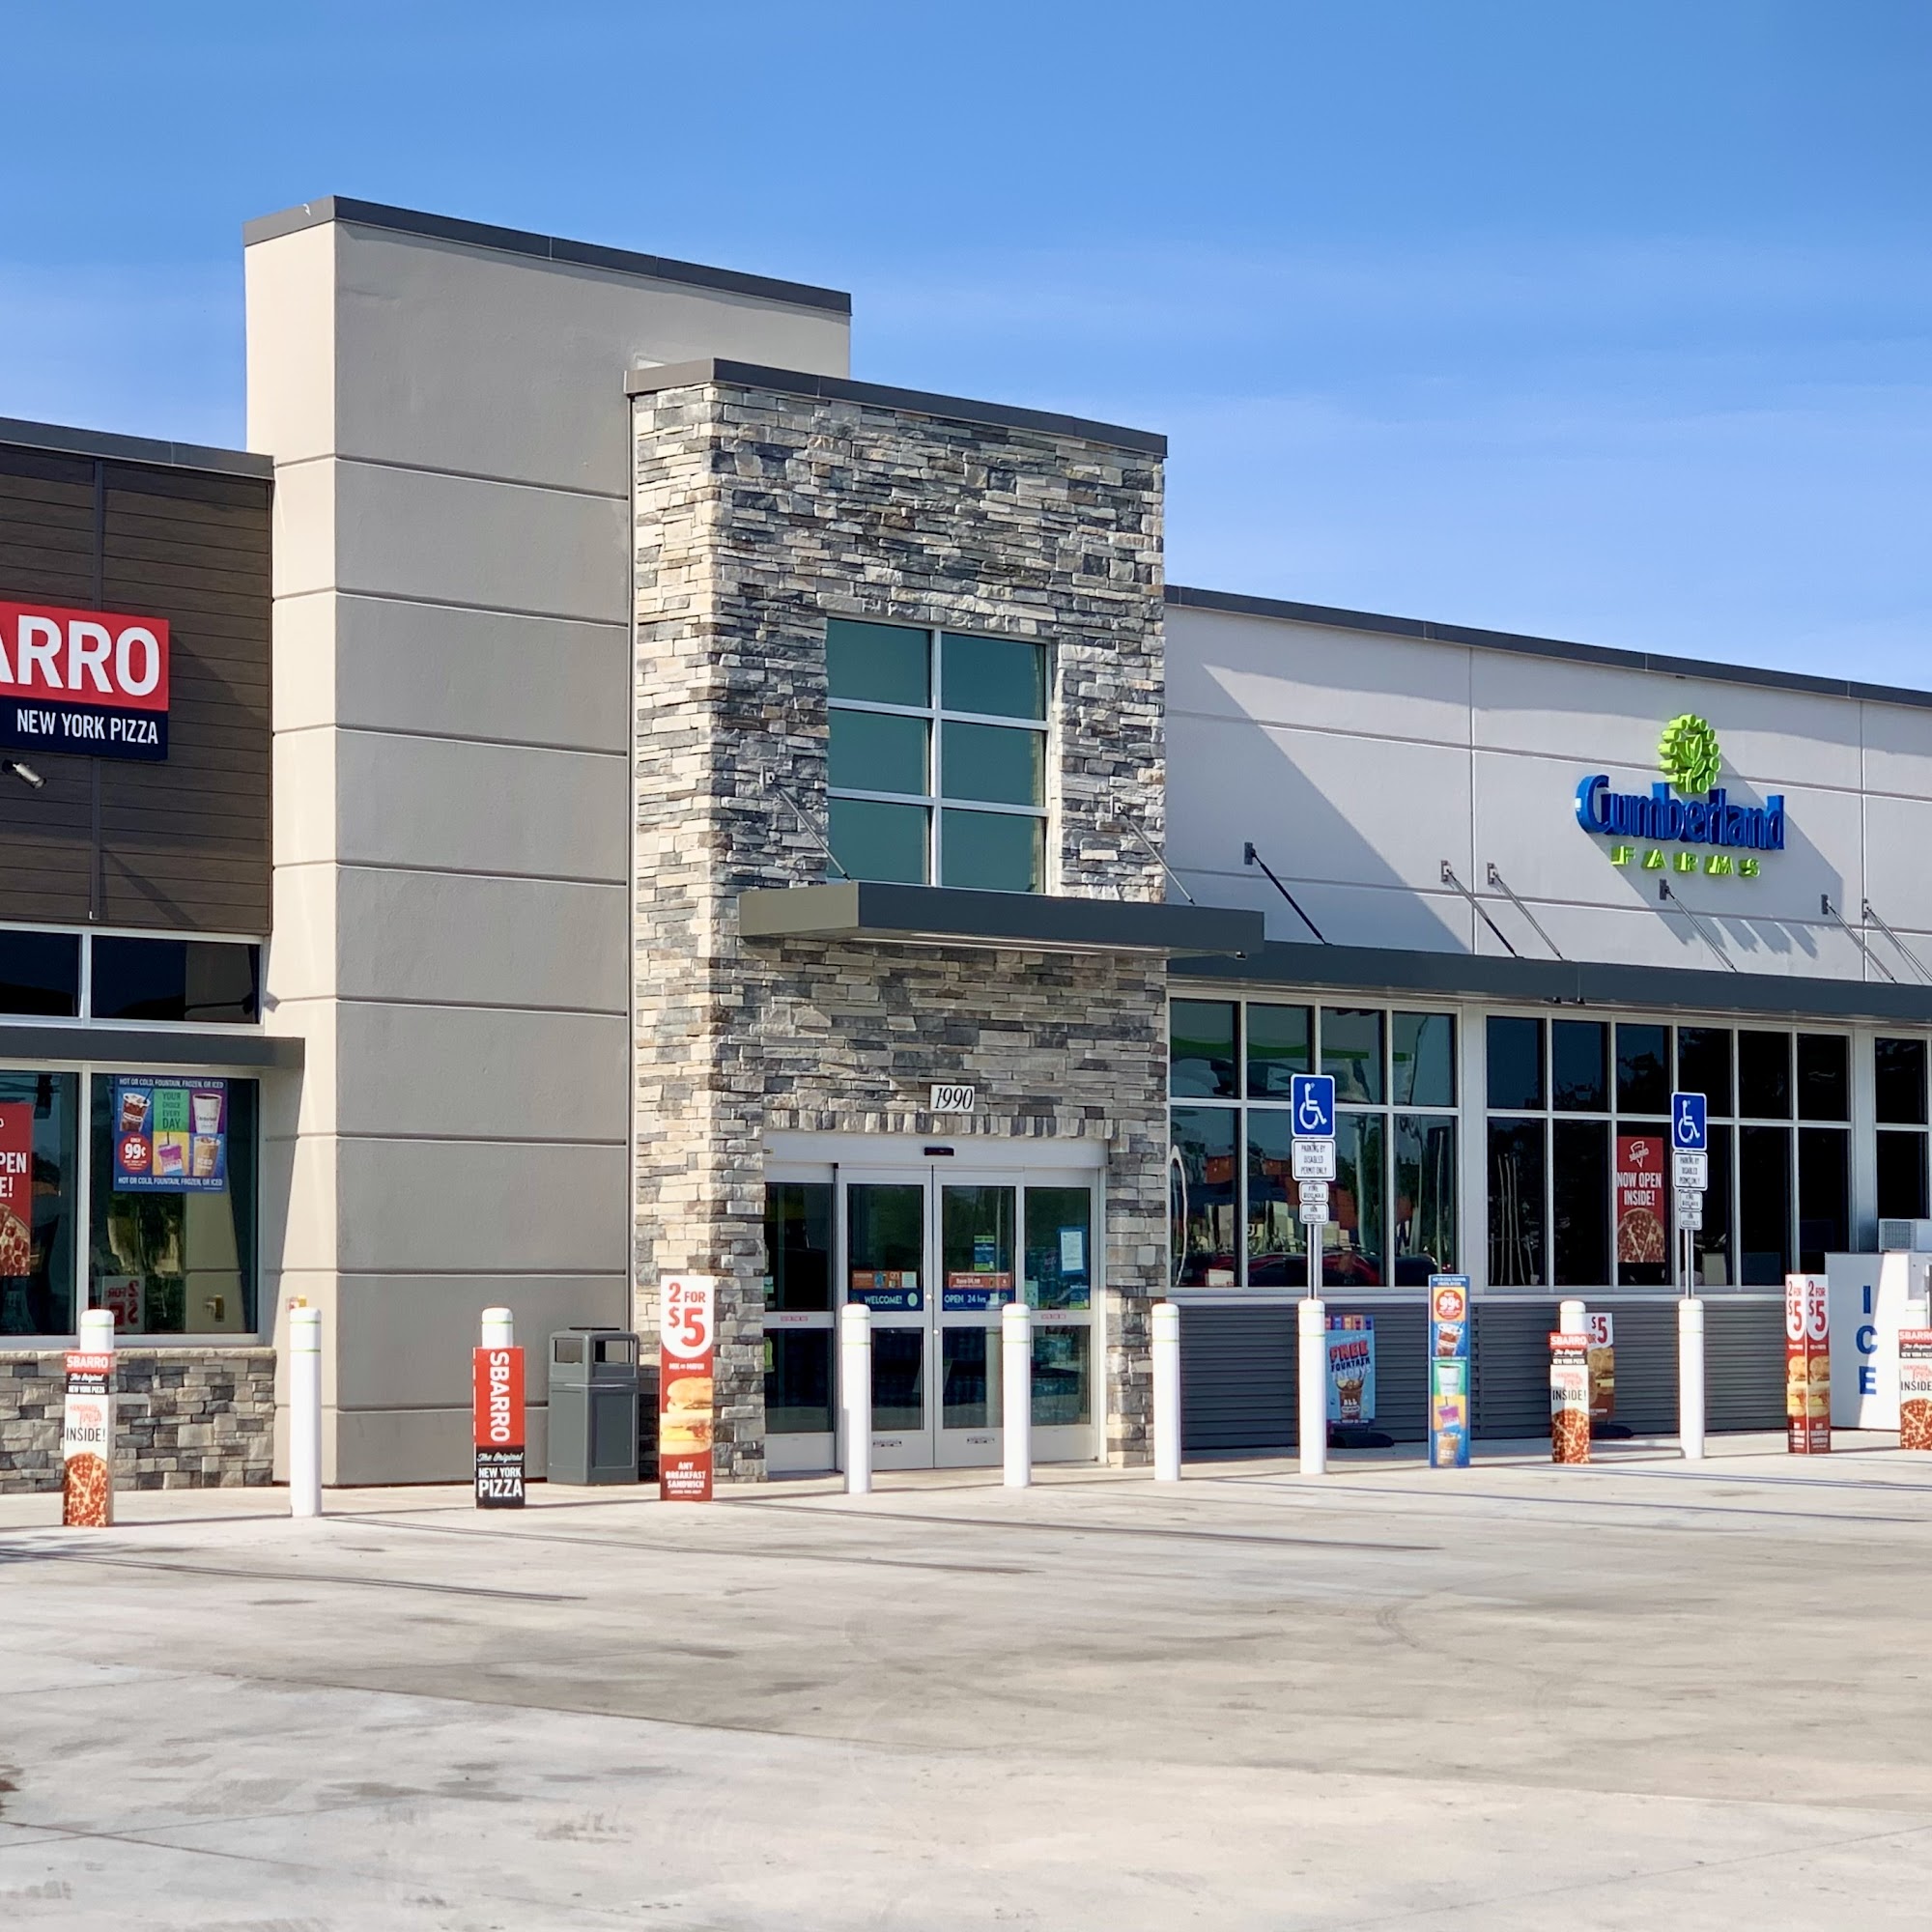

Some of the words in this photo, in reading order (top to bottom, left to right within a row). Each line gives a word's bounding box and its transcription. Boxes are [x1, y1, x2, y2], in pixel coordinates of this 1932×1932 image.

[0, 614, 160, 696] RRO
[17, 708, 56, 735] NEW
[61, 713, 105, 739] YORK
[110, 718, 158, 744] PIZZA
[1575, 775, 1784, 850] Cumberland
[1610, 846, 1760, 877] FARMS
[162, 1092, 181, 1100] YOUR
[934, 1087, 973, 1110] 1990
[162, 1119, 181, 1129] DAY
[1617, 1172, 1636, 1188] NOW
[1638, 1172, 1662, 1188] OPEN
[1624, 1190, 1655, 1206] INSIDE!
[668, 1283, 681, 1303] 2
[684, 1291, 706, 1303] FOR
[1788, 1281, 1793, 1296] 2
[1808, 1280, 1814, 1296] 2
[1815, 1287, 1826, 1296] FOR
[865, 1295, 902, 1304] WELCOME!
[944, 1294, 964, 1303] OPEN
[967, 1294, 976, 1303] 24
[1788, 1299, 1803, 1331] $5
[1808, 1299, 1826, 1332] $5
[668, 1306, 706, 1349] $5
[1592, 1317, 1607, 1344] $5
[1550, 1336, 1587, 1346] SBARRO
[1856, 1285, 1878, 1395] ICE
[1329, 1340, 1369, 1363] FREE
[67, 1355, 108, 1369] SBARRO
[1331, 1357, 1371, 1372] FOUNTAIN
[70, 1373, 81, 1381] The
[81, 1372, 104, 1383] Original
[490, 1351, 510, 1442] SBARRO
[1552, 1390, 1586, 1401] INSIDE!
[67, 1428, 105, 1442] INSIDE!
[477, 1453, 493, 1462] The
[493, 1452, 524, 1463] Original
[478, 1466, 497, 1478] NEW
[499, 1466, 522, 1478] YORK
[678, 1462, 694, 1470] ANY
[478, 1479, 523, 1497] PIZZA
[668, 1480, 704, 1489] SANDWICH
